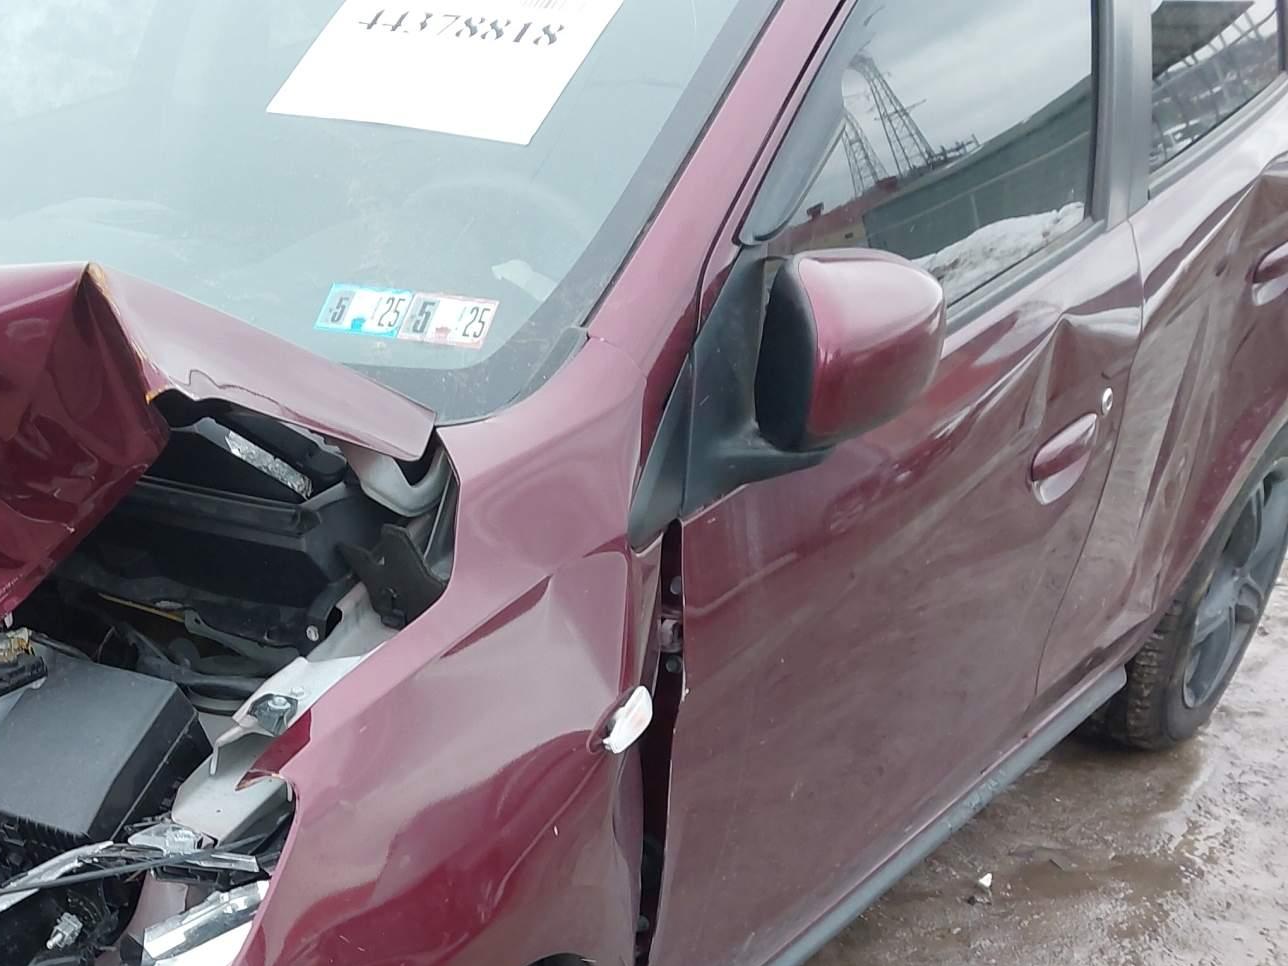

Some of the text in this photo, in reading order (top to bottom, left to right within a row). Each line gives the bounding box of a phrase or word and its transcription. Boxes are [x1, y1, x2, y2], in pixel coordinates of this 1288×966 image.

[358, 9, 566, 46] 44378818
[330, 297, 349, 323] 5
[377, 297, 406, 327] 25
[412, 301, 435, 333] 5
[461, 306, 491, 338] 25
